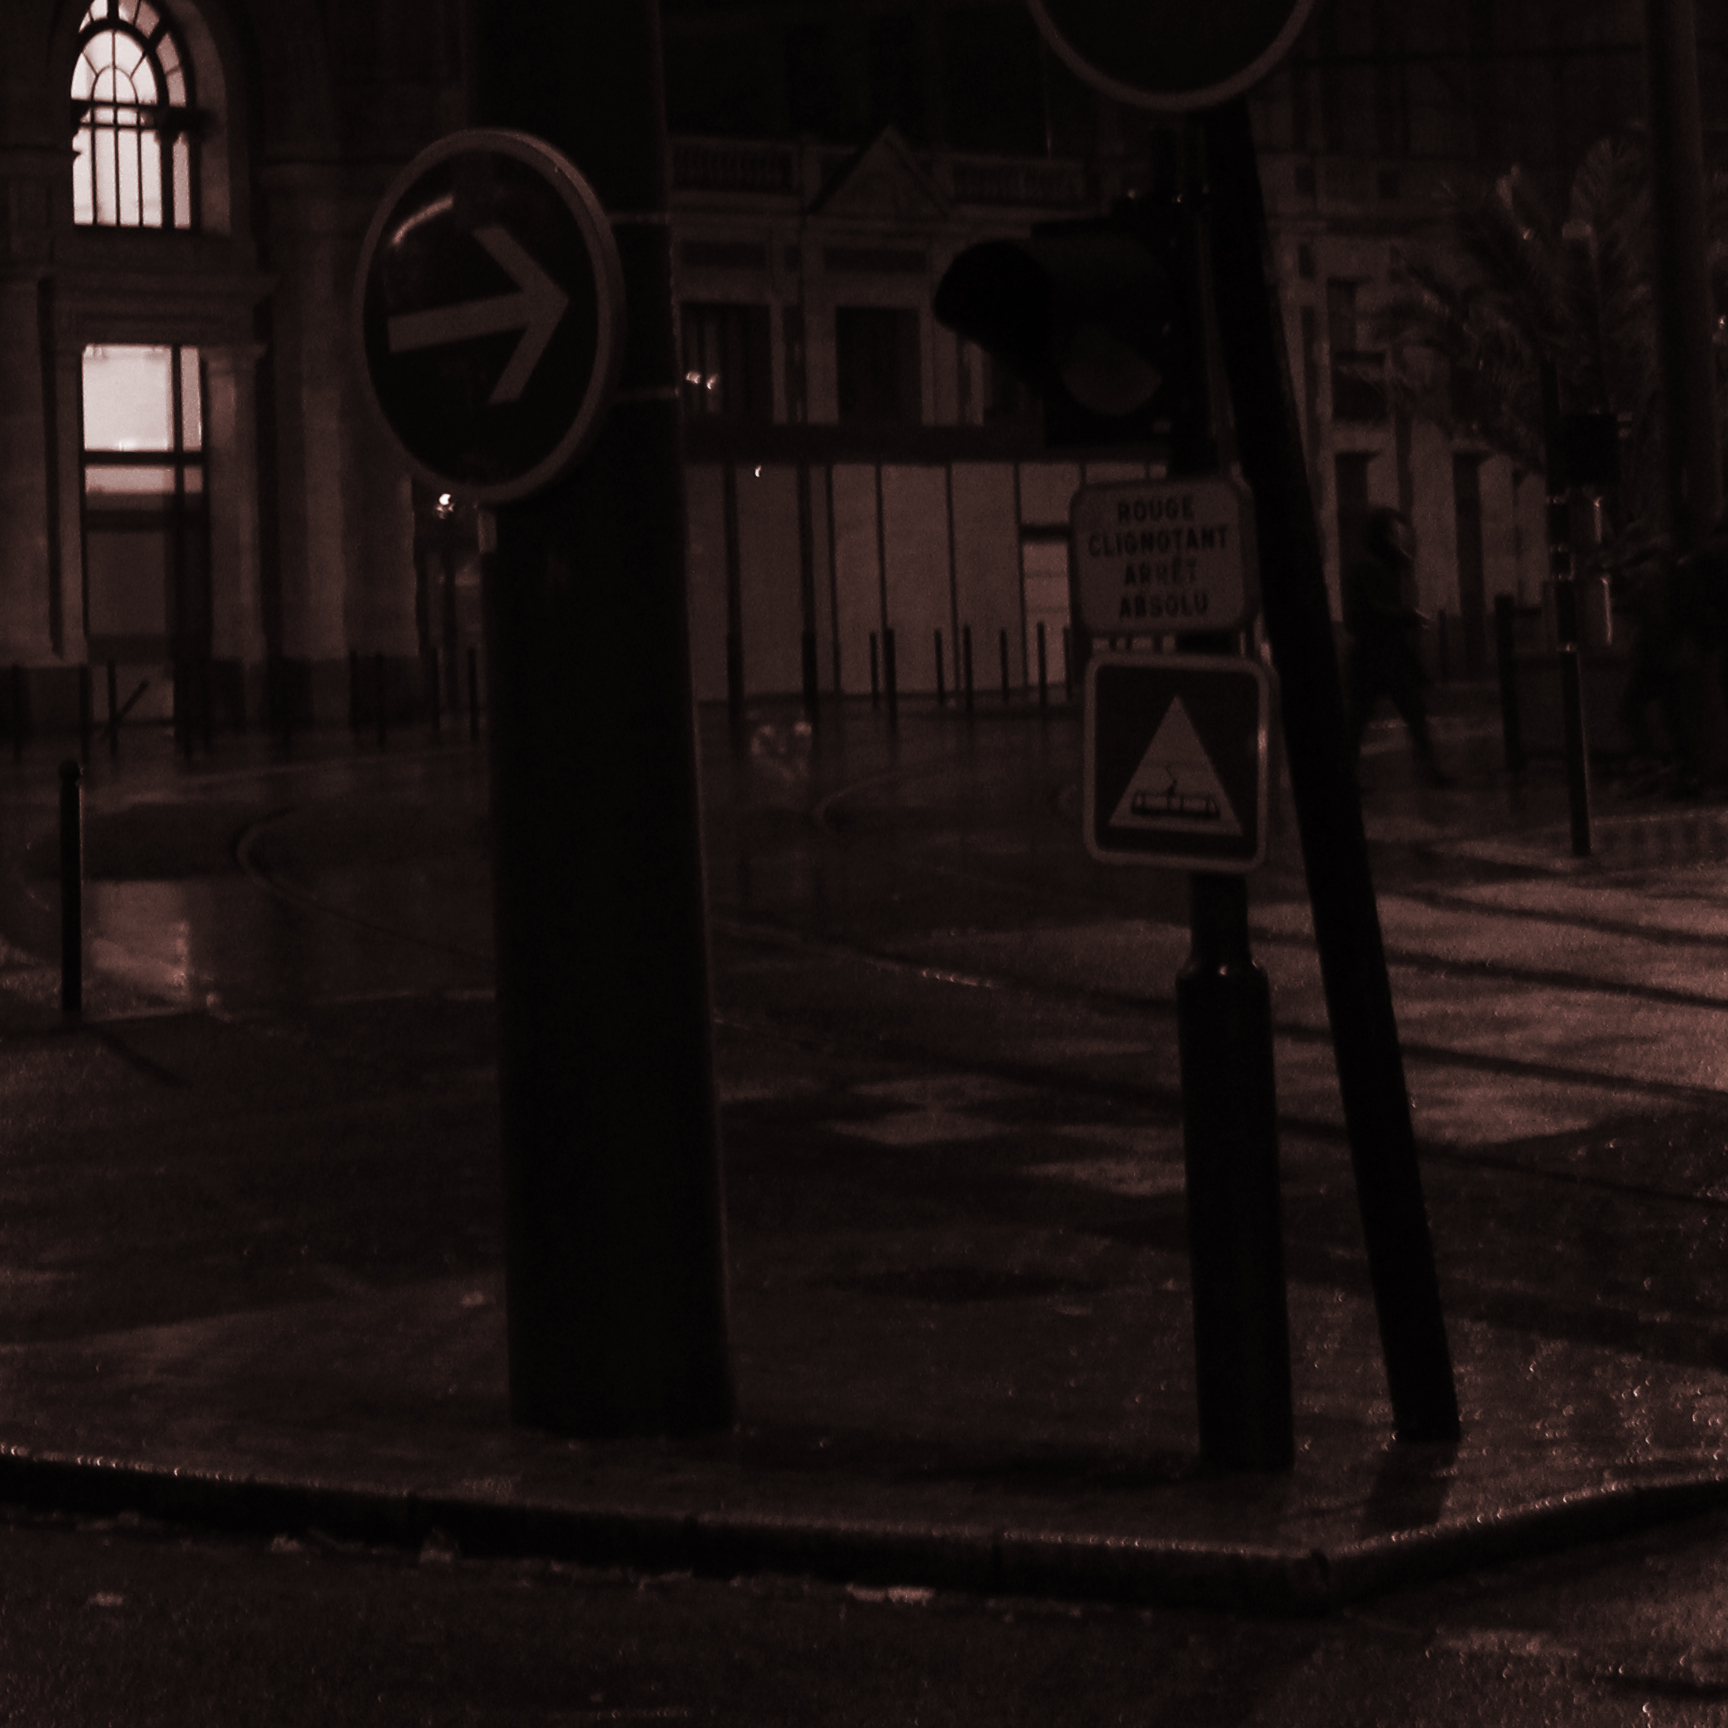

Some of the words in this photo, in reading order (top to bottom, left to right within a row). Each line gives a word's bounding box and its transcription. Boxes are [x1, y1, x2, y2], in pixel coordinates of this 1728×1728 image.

[1118, 497, 1194, 522] ROUGE
[1088, 525, 1229, 558] CLIGNOTANT
[1119, 593, 1208, 618] ABSOLU
